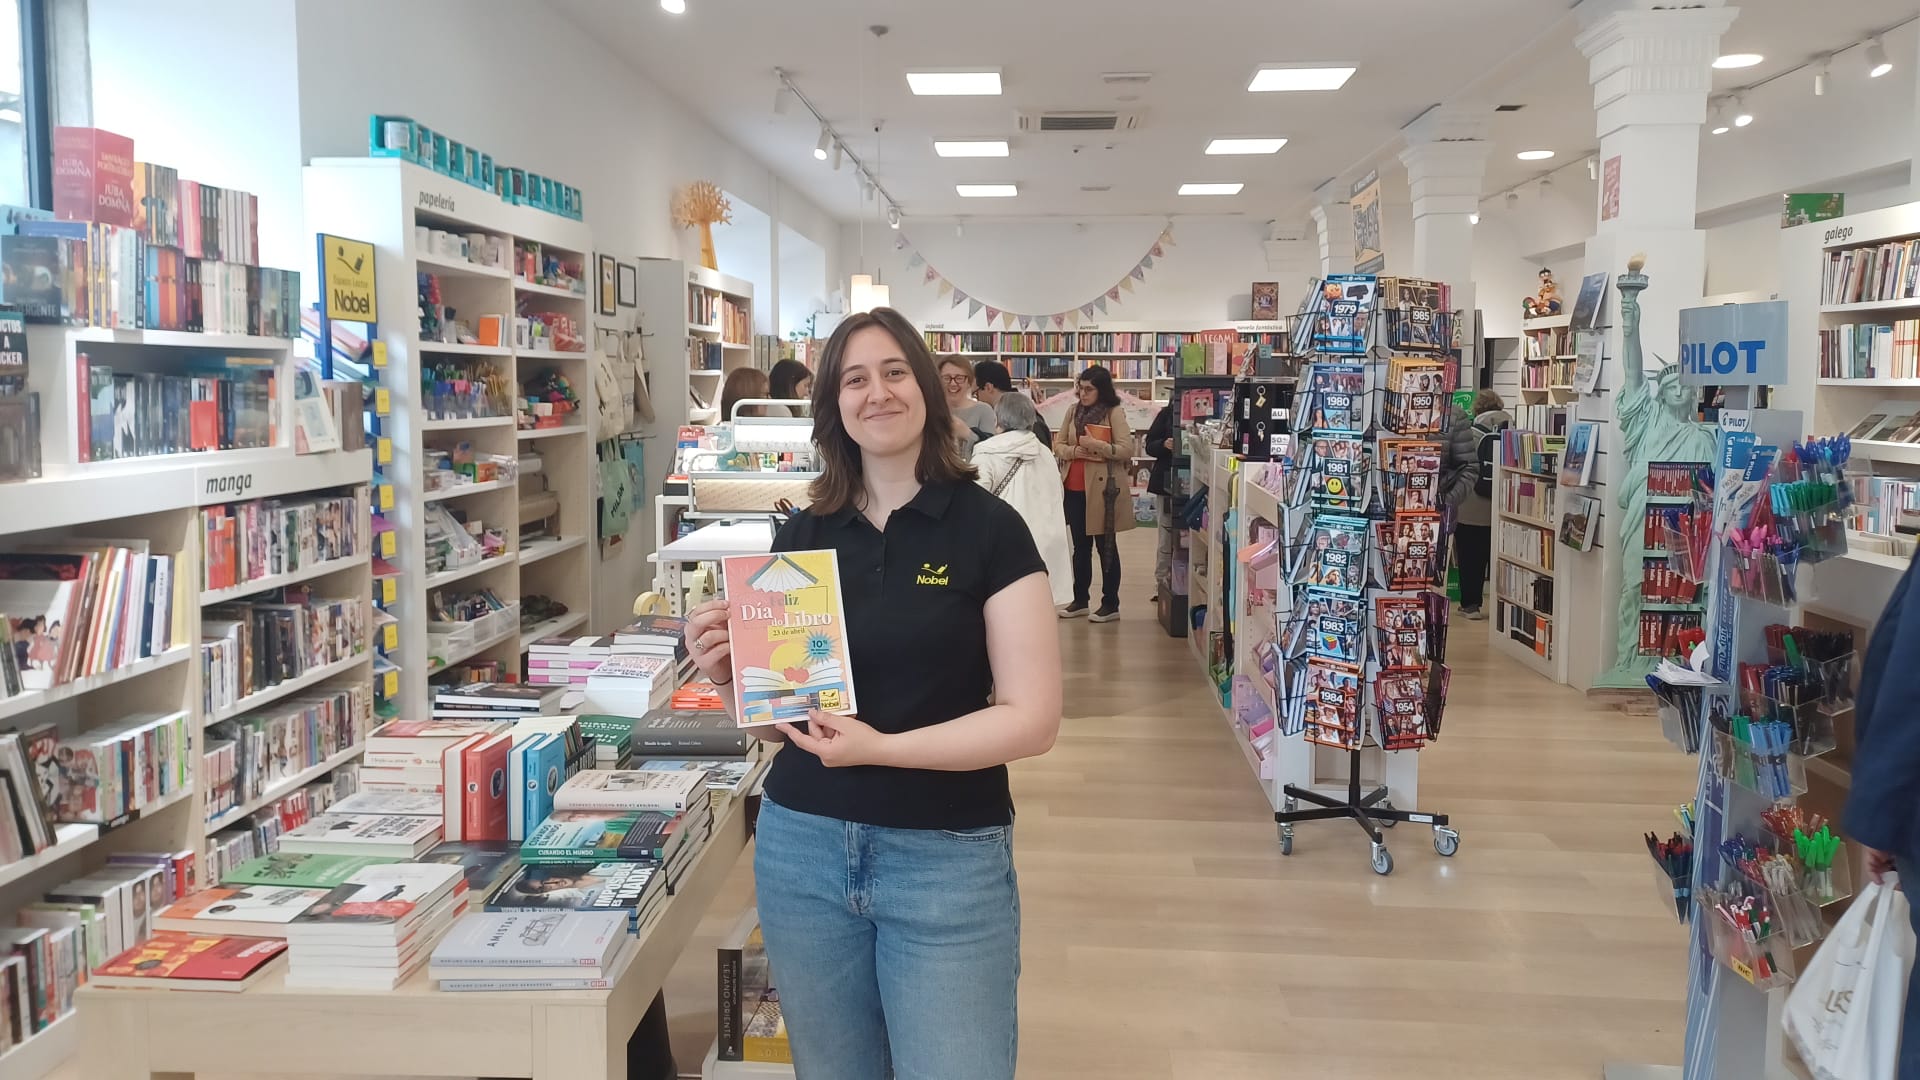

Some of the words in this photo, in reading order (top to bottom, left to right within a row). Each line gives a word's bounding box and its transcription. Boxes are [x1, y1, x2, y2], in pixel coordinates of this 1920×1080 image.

[1824, 226, 1853, 244] galego
[334, 288, 370, 314] Nobel
[1334, 303, 1357, 315] 1979
[1412, 311, 1430, 321] 1985
[0, 319, 22, 333] CTOS
[0, 351, 23, 365] CKER
[1681, 340, 1766, 375] PILOT
[1326, 396, 1350, 407] 1980
[1412, 396, 1431, 406] 1950
[1729, 417, 1746, 428] PILOT
[1725, 447, 1733, 468] PILOT
[1326, 463, 1348, 473] 1981
[1744, 461, 1754, 481] PILOT
[206, 473, 252, 496] manga
[1411, 476, 1428, 486] 1951
[1408, 545, 1427, 556] 1952
[1325, 552, 1347, 564] 1982
[916, 574, 949, 586] Nobel
[741, 602, 773, 621] Día
[771, 617, 784, 627] do
[783, 611, 832, 628] Libro
[1321, 620, 1344, 633] 1983
[1398, 632, 1417, 643] 1953
[1320, 690, 1344, 702] 1984
[1395, 702, 1414, 712] 1954
[593, 863, 638, 907] IMPOSIBLE
[617, 867, 655, 899] NADA
[723, 964, 731, 999] LEJANO
[723, 1002, 731, 1038] ORIENTE
